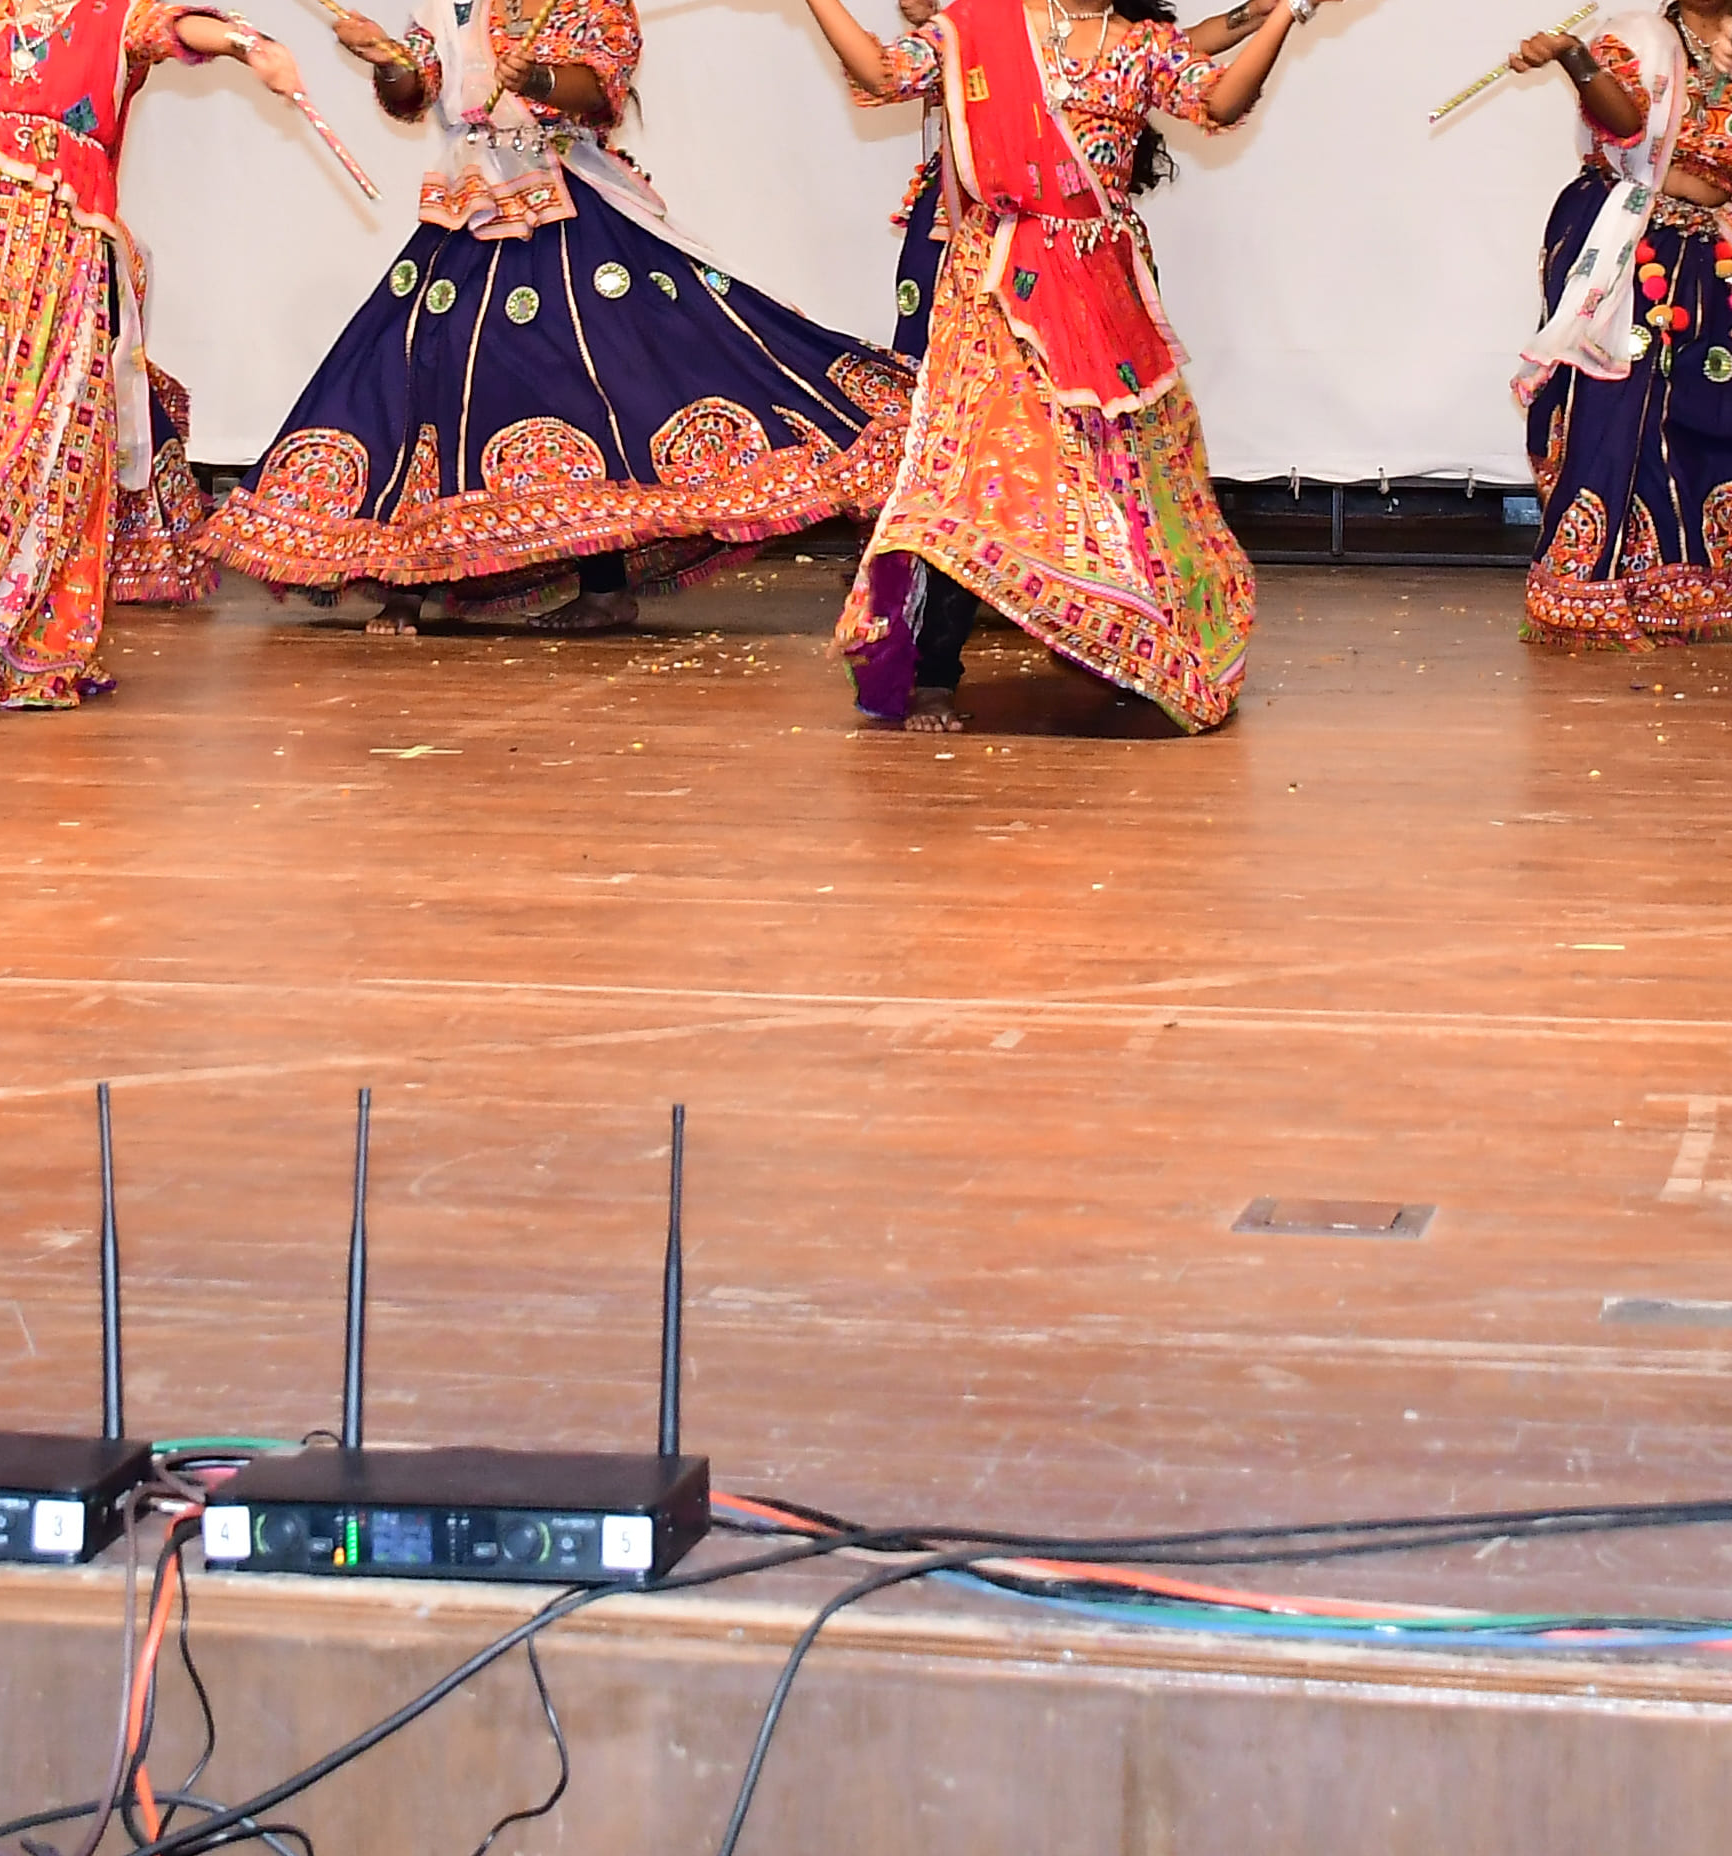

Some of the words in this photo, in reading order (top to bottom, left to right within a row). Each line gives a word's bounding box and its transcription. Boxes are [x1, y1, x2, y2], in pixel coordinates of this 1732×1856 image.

[54, 1515, 63, 1537] 3
[221, 1523, 229, 1540] 4
[622, 1532, 631, 1553] 5
